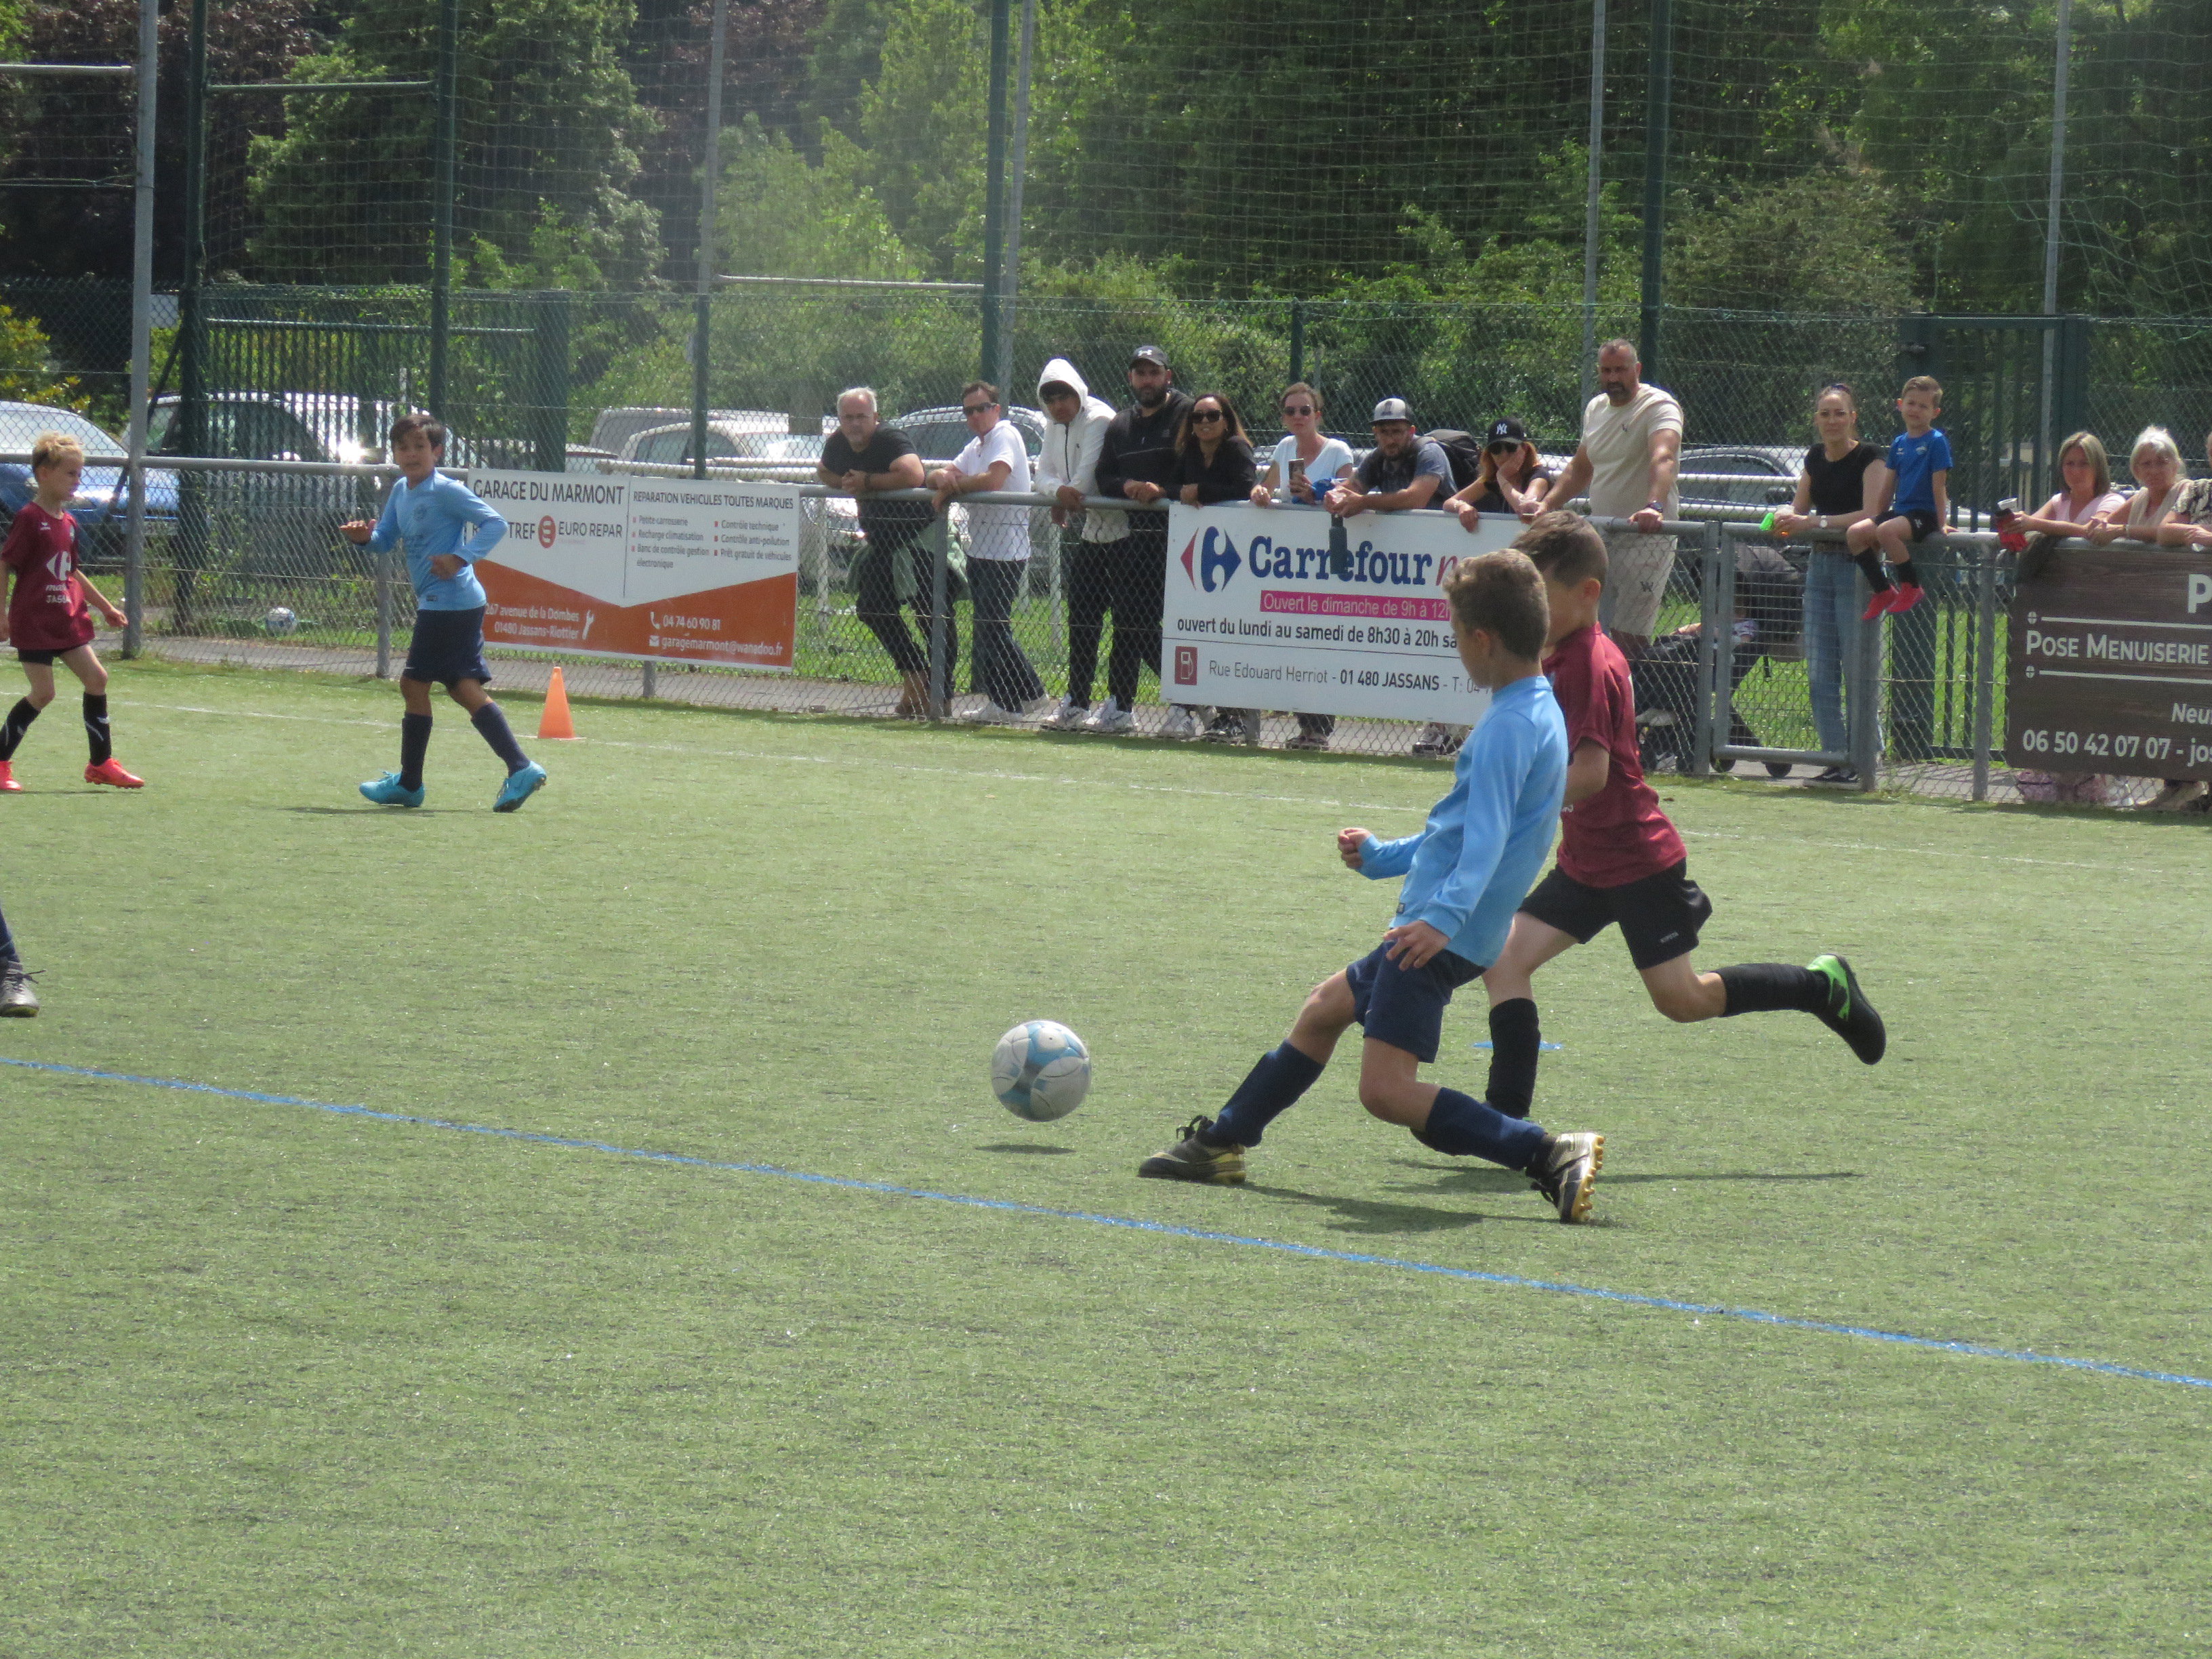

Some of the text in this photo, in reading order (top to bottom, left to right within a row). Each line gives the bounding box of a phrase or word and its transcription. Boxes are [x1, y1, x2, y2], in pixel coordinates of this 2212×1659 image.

[473, 478, 626, 505] GARAGE DU MARMONT
[633, 491, 794, 511] REPARATION VEHICULES TOUTES MARQUES
[558, 521, 588, 537] EURO
[589, 524, 623, 539] REPAR
[756, 550, 764, 559] de
[499, 606, 528, 618] avenue
[529, 605, 538, 619] de
[547, 607, 580, 623] Dombes
[1263, 593, 1305, 612] Ouvert
[1307, 595, 1319, 613] le
[1322, 596, 1380, 616] dimanche
[1382, 600, 1398, 616] de
[1401, 600, 1416, 617] 9h
[1419, 602, 1427, 618] à
[518, 623, 580, 640] Jassans-Riottier
[662, 615, 674, 628] 04
[687, 617, 698, 629] 60
[699, 617, 710, 630] 90
[712, 619, 721, 631] 81
[1176, 617, 1216, 634] ouvert
[1219, 617, 1235, 635] du
[1238, 618, 1272, 637] lundi
[1274, 625, 1292, 638] au
[1294, 625, 1344, 641] samedi
[1347, 626, 1364, 642] de
[1367, 626, 1400, 645] 8h30
[1403, 628, 1412, 646] à
[1414, 629, 1439, 648] 20h
[661, 636, 783, 657] garagemarmont@wanadoo.fr
[1208, 659, 1231, 677] Rue
[1234, 661, 1282, 680] Edouard
[1286, 665, 1328, 684] Herriot
[1339, 668, 1354, 685] 01
[1357, 670, 1379, 687] 480
[1381, 672, 1440, 691] JASSANS
[2171, 702, 2212, 726] Neu
[2022, 729, 2049, 752] 06
[2053, 731, 2078, 754] 50
[2083, 733, 2110, 756] 42
[2114, 735, 2140, 758] 07
[2145, 737, 2172, 760] 07
